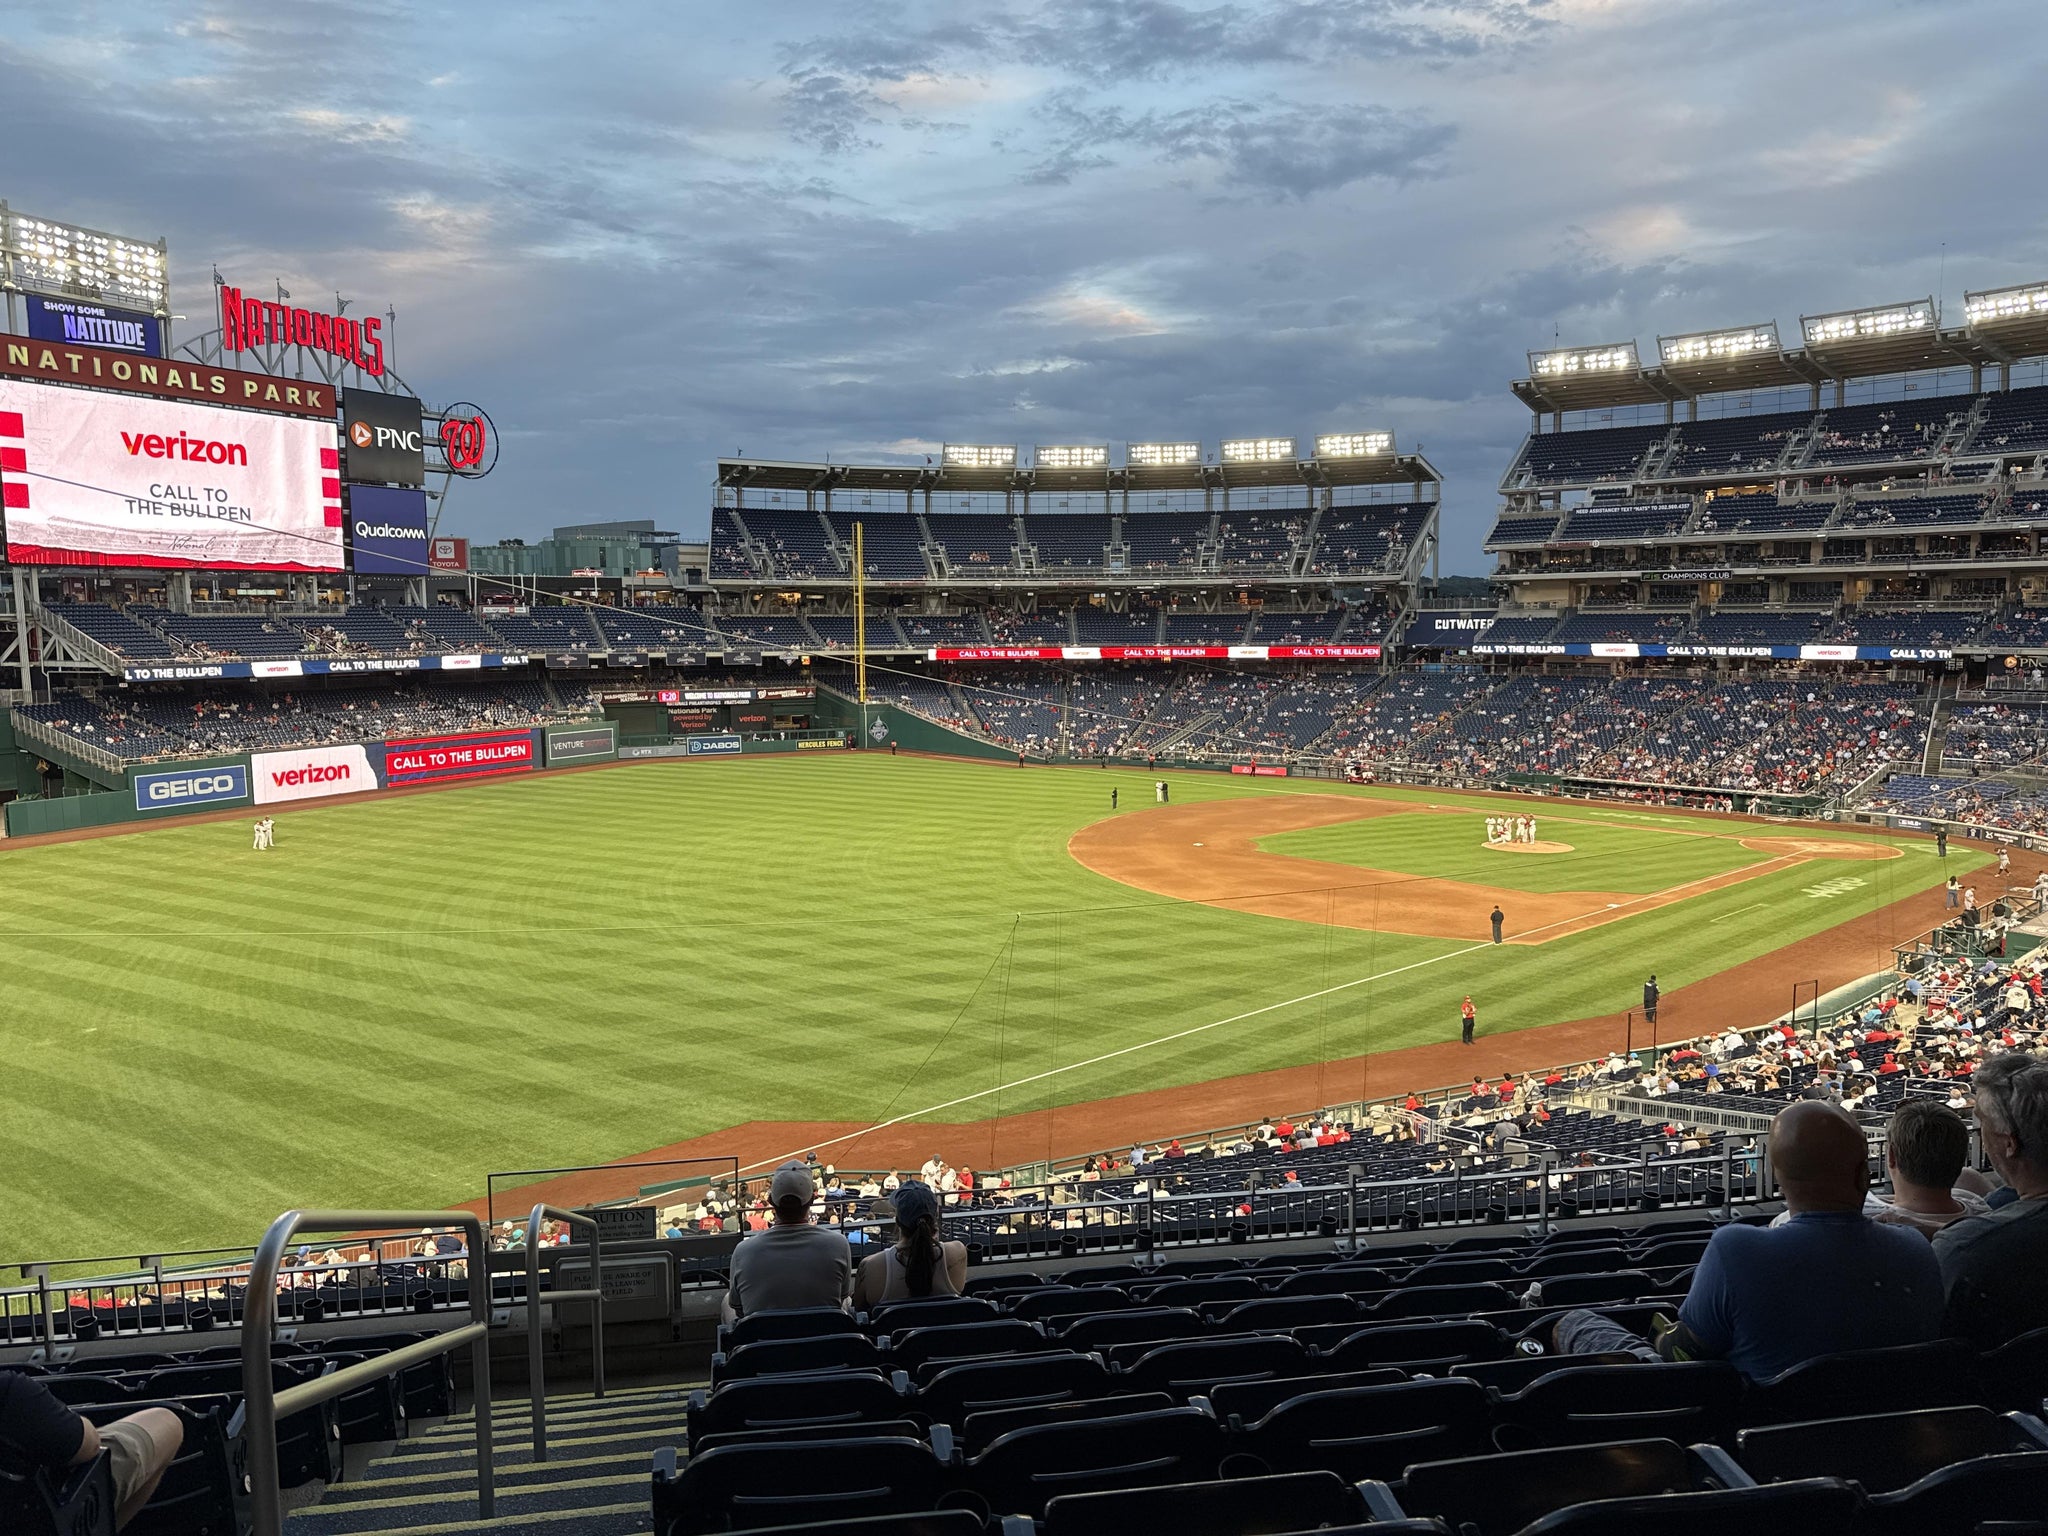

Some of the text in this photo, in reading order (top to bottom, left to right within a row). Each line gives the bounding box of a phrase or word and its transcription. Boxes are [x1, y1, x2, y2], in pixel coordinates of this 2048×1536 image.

[43, 301, 106, 317] SHOW SOME
[63, 314, 146, 346] NATITUDE
[221, 285, 384, 376] NATIONALS
[7, 344, 226, 394] NATIONALS
[243, 380, 322, 408] PARK
[375, 426, 421, 452] PNC
[120, 430, 247, 466] verizon
[150, 483, 228, 503] CALL TO
[125, 499, 251, 521] THE BULLPEN
[355, 521, 426, 539] Qualcomm
[1662, 572, 1708, 580] CHAMPIONS
[1709, 571, 1730, 579] CLUB
[1435, 618, 1494, 630] CUTWATER
[959, 649, 1040, 657] CALL TO THE BULLPEN
[1172, 648, 1205, 656] BULLPEN
[1472, 645, 1565, 654] CALL TO THE BULLPEN
[1666, 646, 1772, 656] CALL TO THE BULLPEN
[1890, 649, 1918, 658] CALL
[1919, 649, 1935, 659] TO
[329, 659, 420, 671] CALL TO THE BULLPEN
[502, 656, 520, 664] CALL
[134, 669, 150, 679] TO
[153, 668, 173, 678] THE
[176, 666, 222, 678] BULLPEN
[266, 665, 289, 673] verizon
[684, 692, 707, 700] WELCOME
[739, 714, 766, 722] verizon
[553, 740, 584, 750] VENTURE
[702, 741, 740, 750] DABOS
[393, 745, 526, 770] CALL TO THE BULLPEN
[272, 763, 350, 787] verizon
[149, 774, 234, 800] GEICO
[592, 1211, 646, 1223] AUTION
